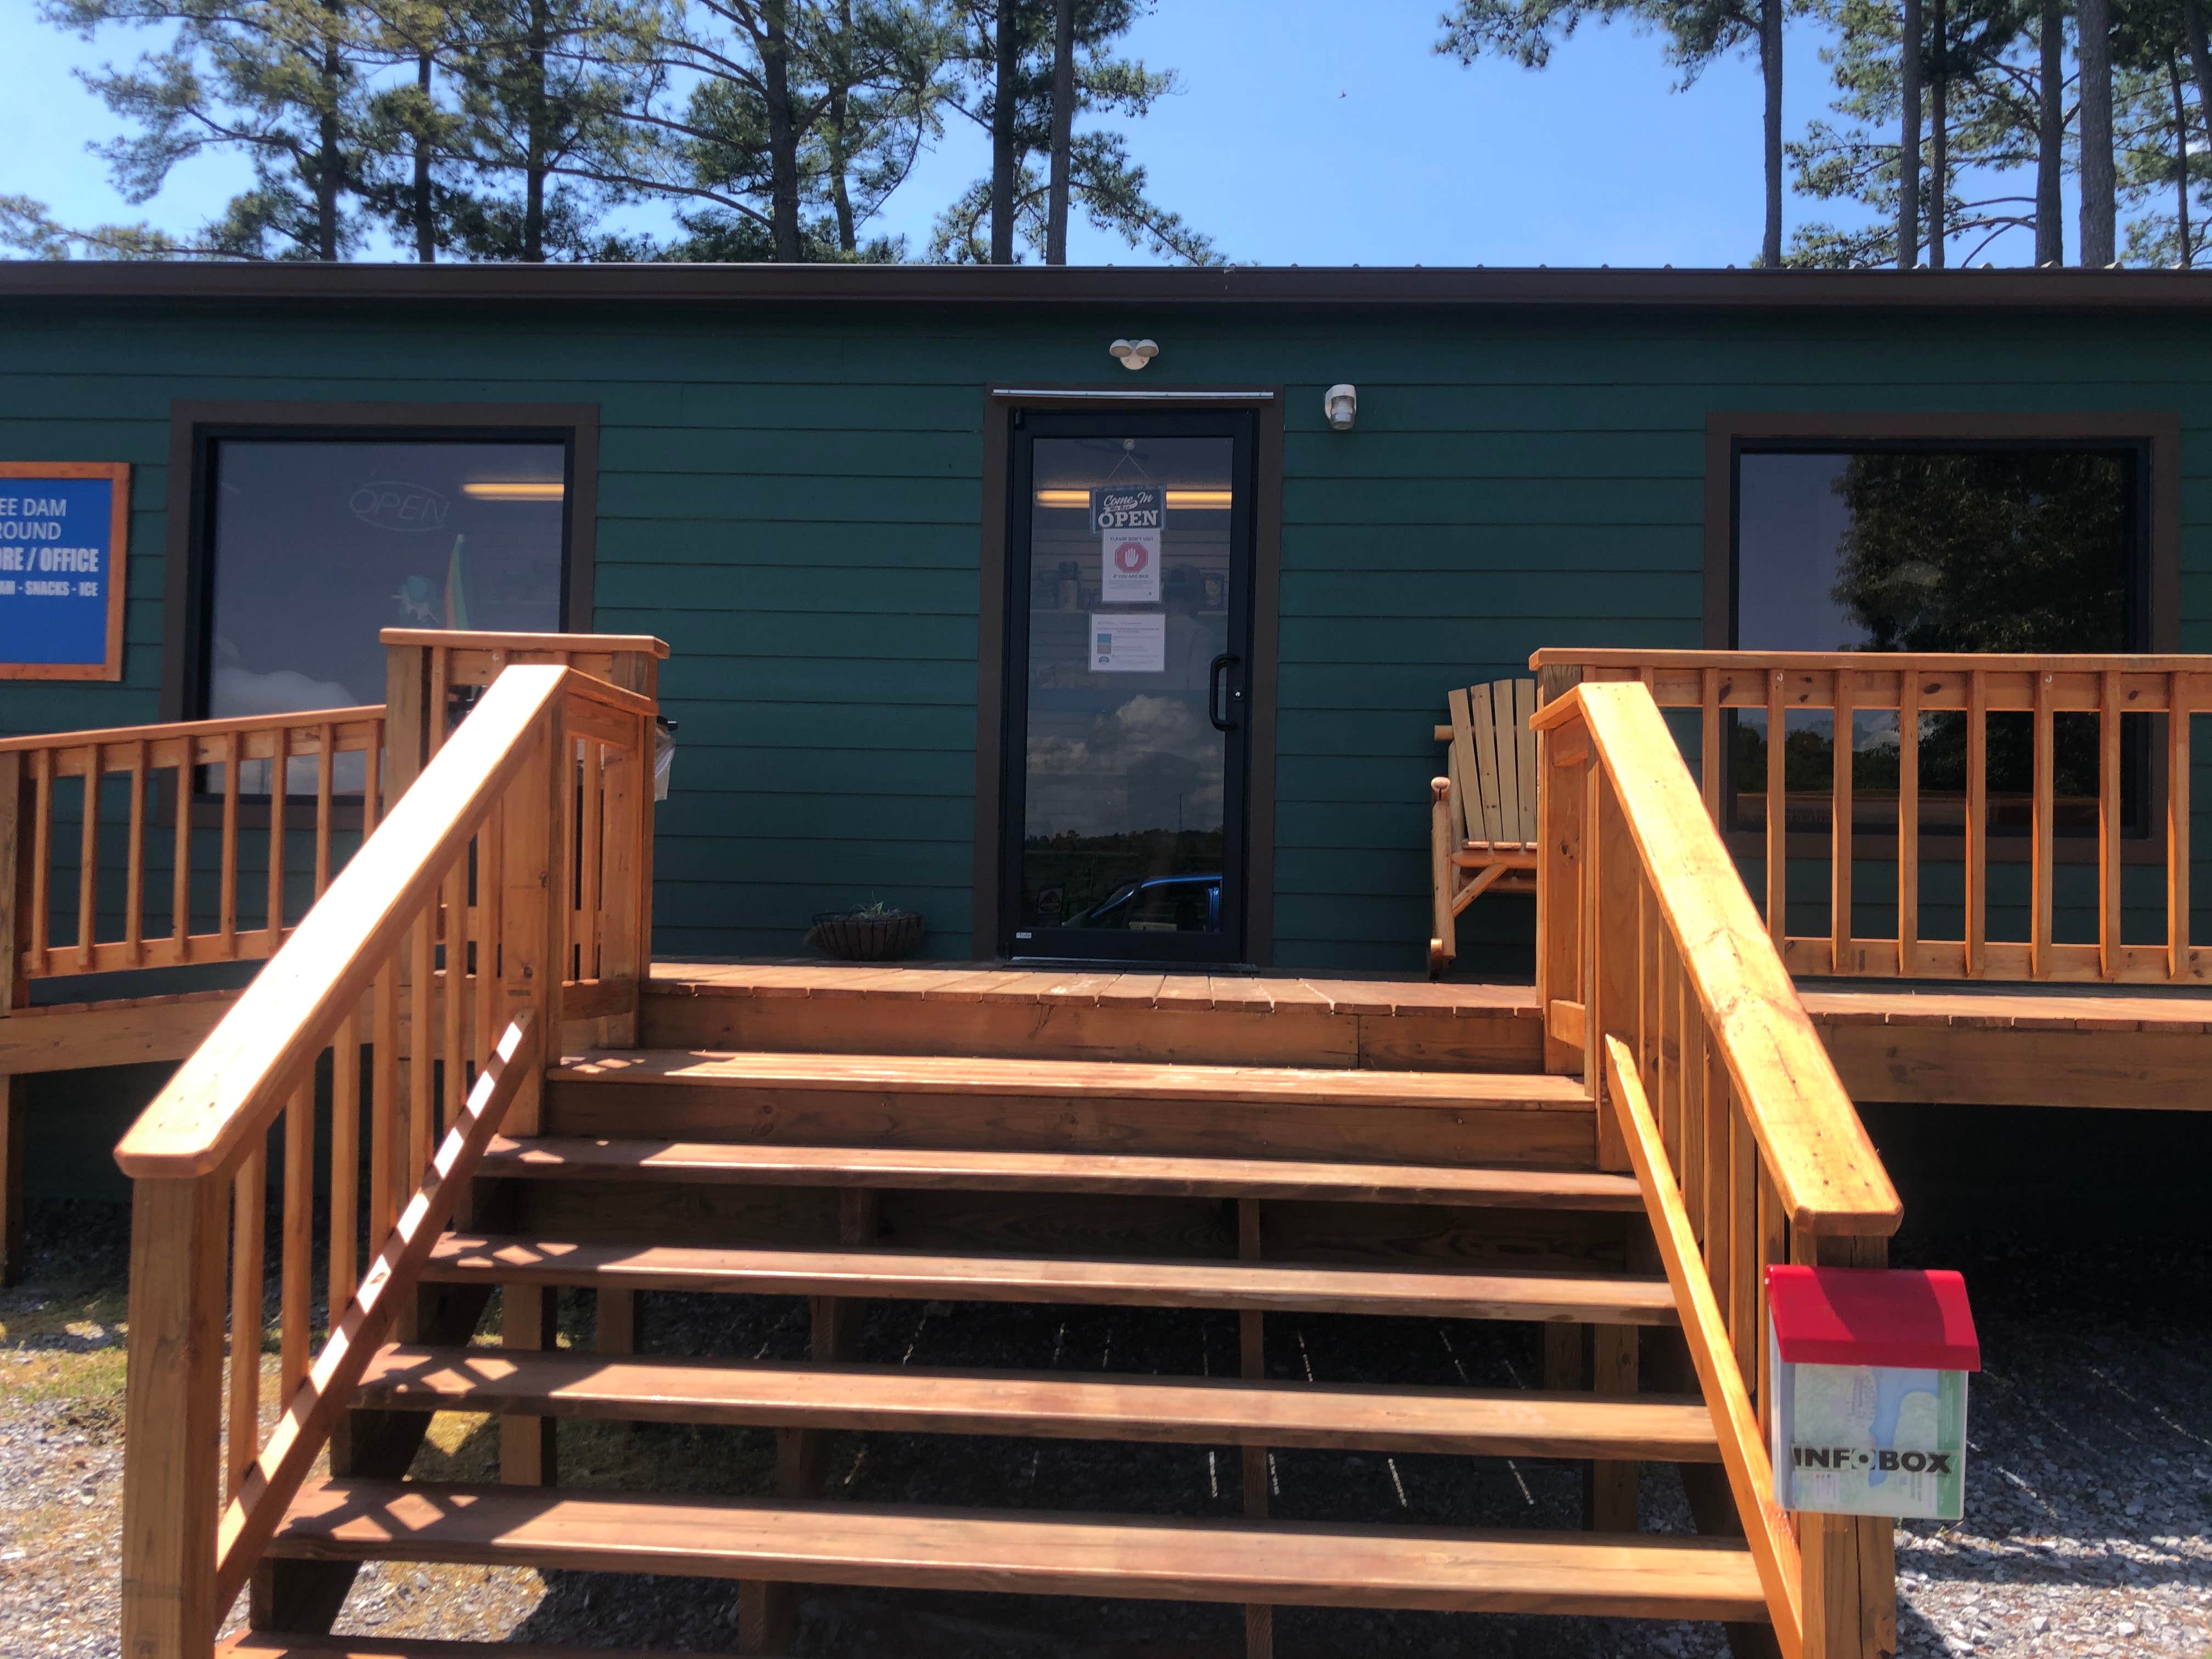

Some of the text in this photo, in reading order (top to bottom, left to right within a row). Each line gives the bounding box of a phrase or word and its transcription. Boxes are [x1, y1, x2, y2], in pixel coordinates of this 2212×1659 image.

[22, 498, 66, 517] DAM
[350, 489, 450, 524] OPEN
[1103, 492, 1153, 506] Come In
[1098, 510, 1158, 527] OPEN
[0, 521, 61, 540] OUND
[40, 548, 99, 572] OFFICE
[25, 580, 70, 596] SNACKS
[79, 582, 98, 597] ICE
[1878, 1449, 1951, 1474] BOX
